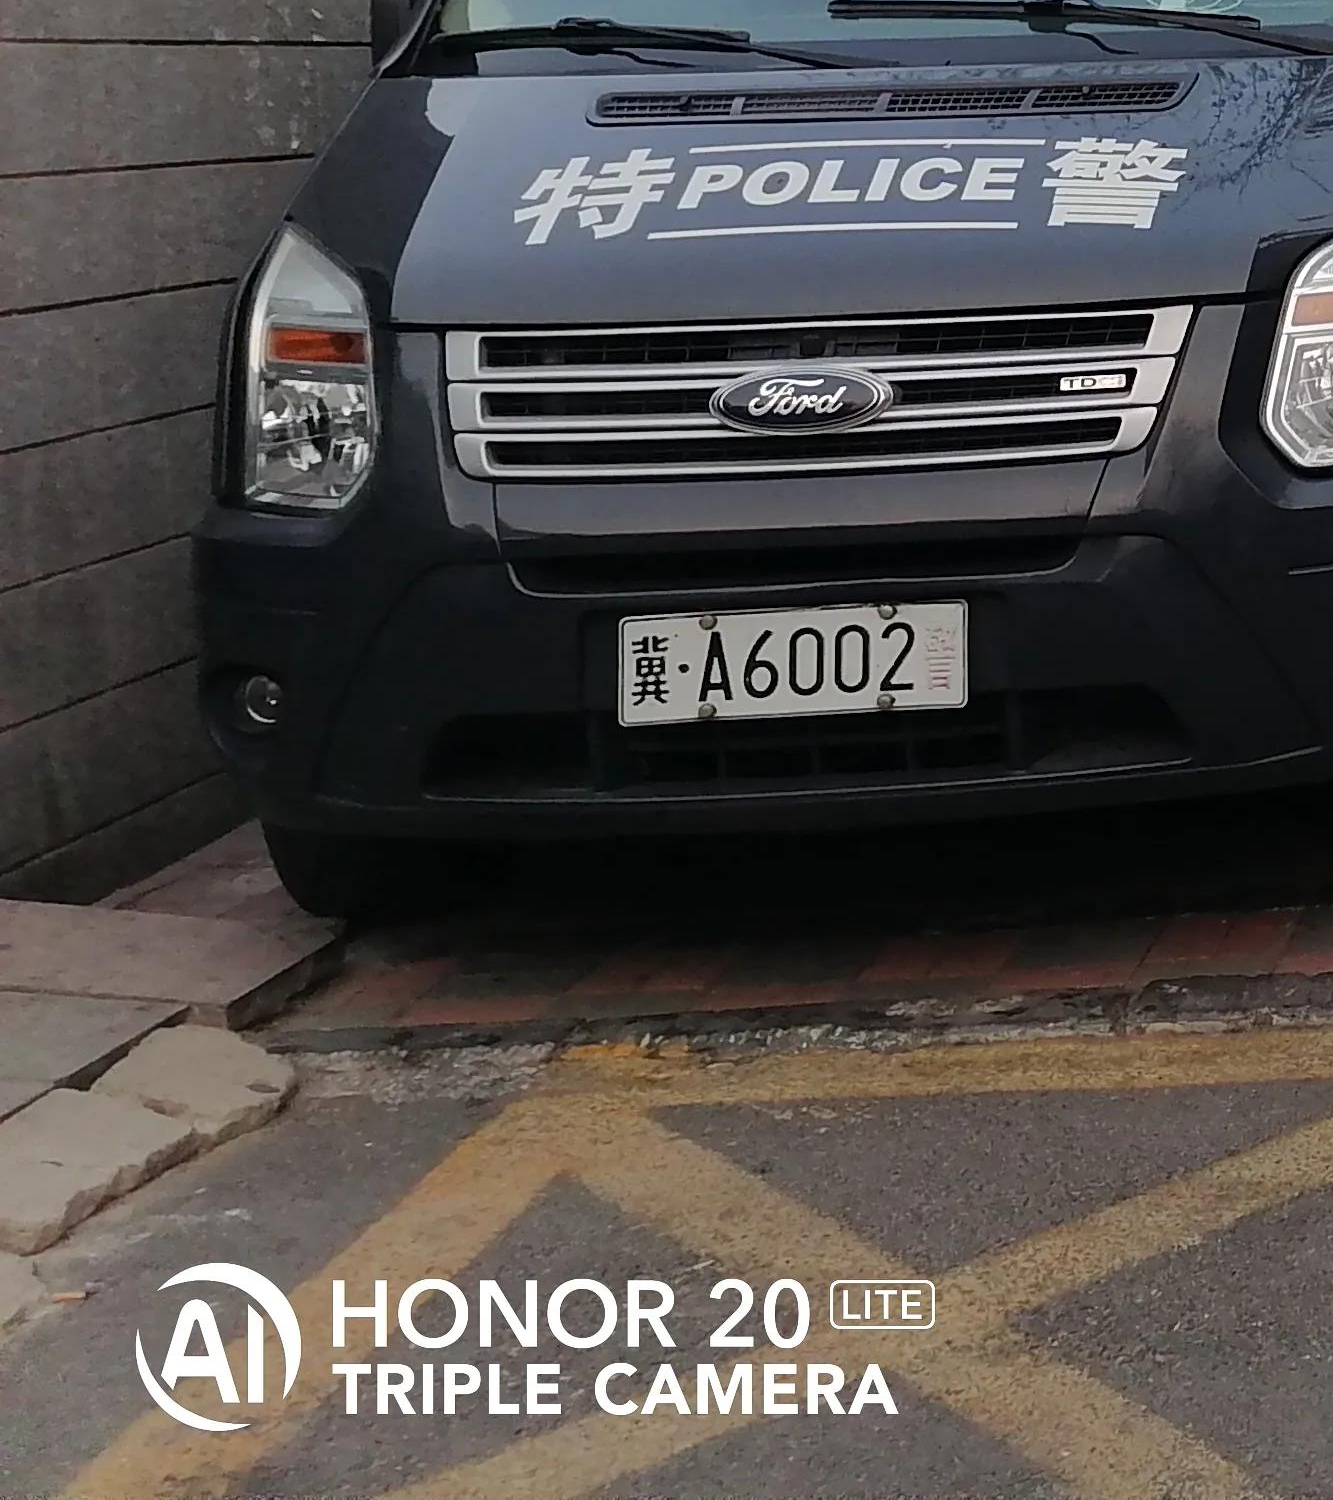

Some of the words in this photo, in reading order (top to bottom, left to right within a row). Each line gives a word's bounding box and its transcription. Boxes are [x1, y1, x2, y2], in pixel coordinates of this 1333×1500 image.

[513, 148, 675, 245] 特
[678, 158, 1024, 210] POLICE
[1042, 137, 1189, 229] 警
[748, 378, 847, 417] Ford
